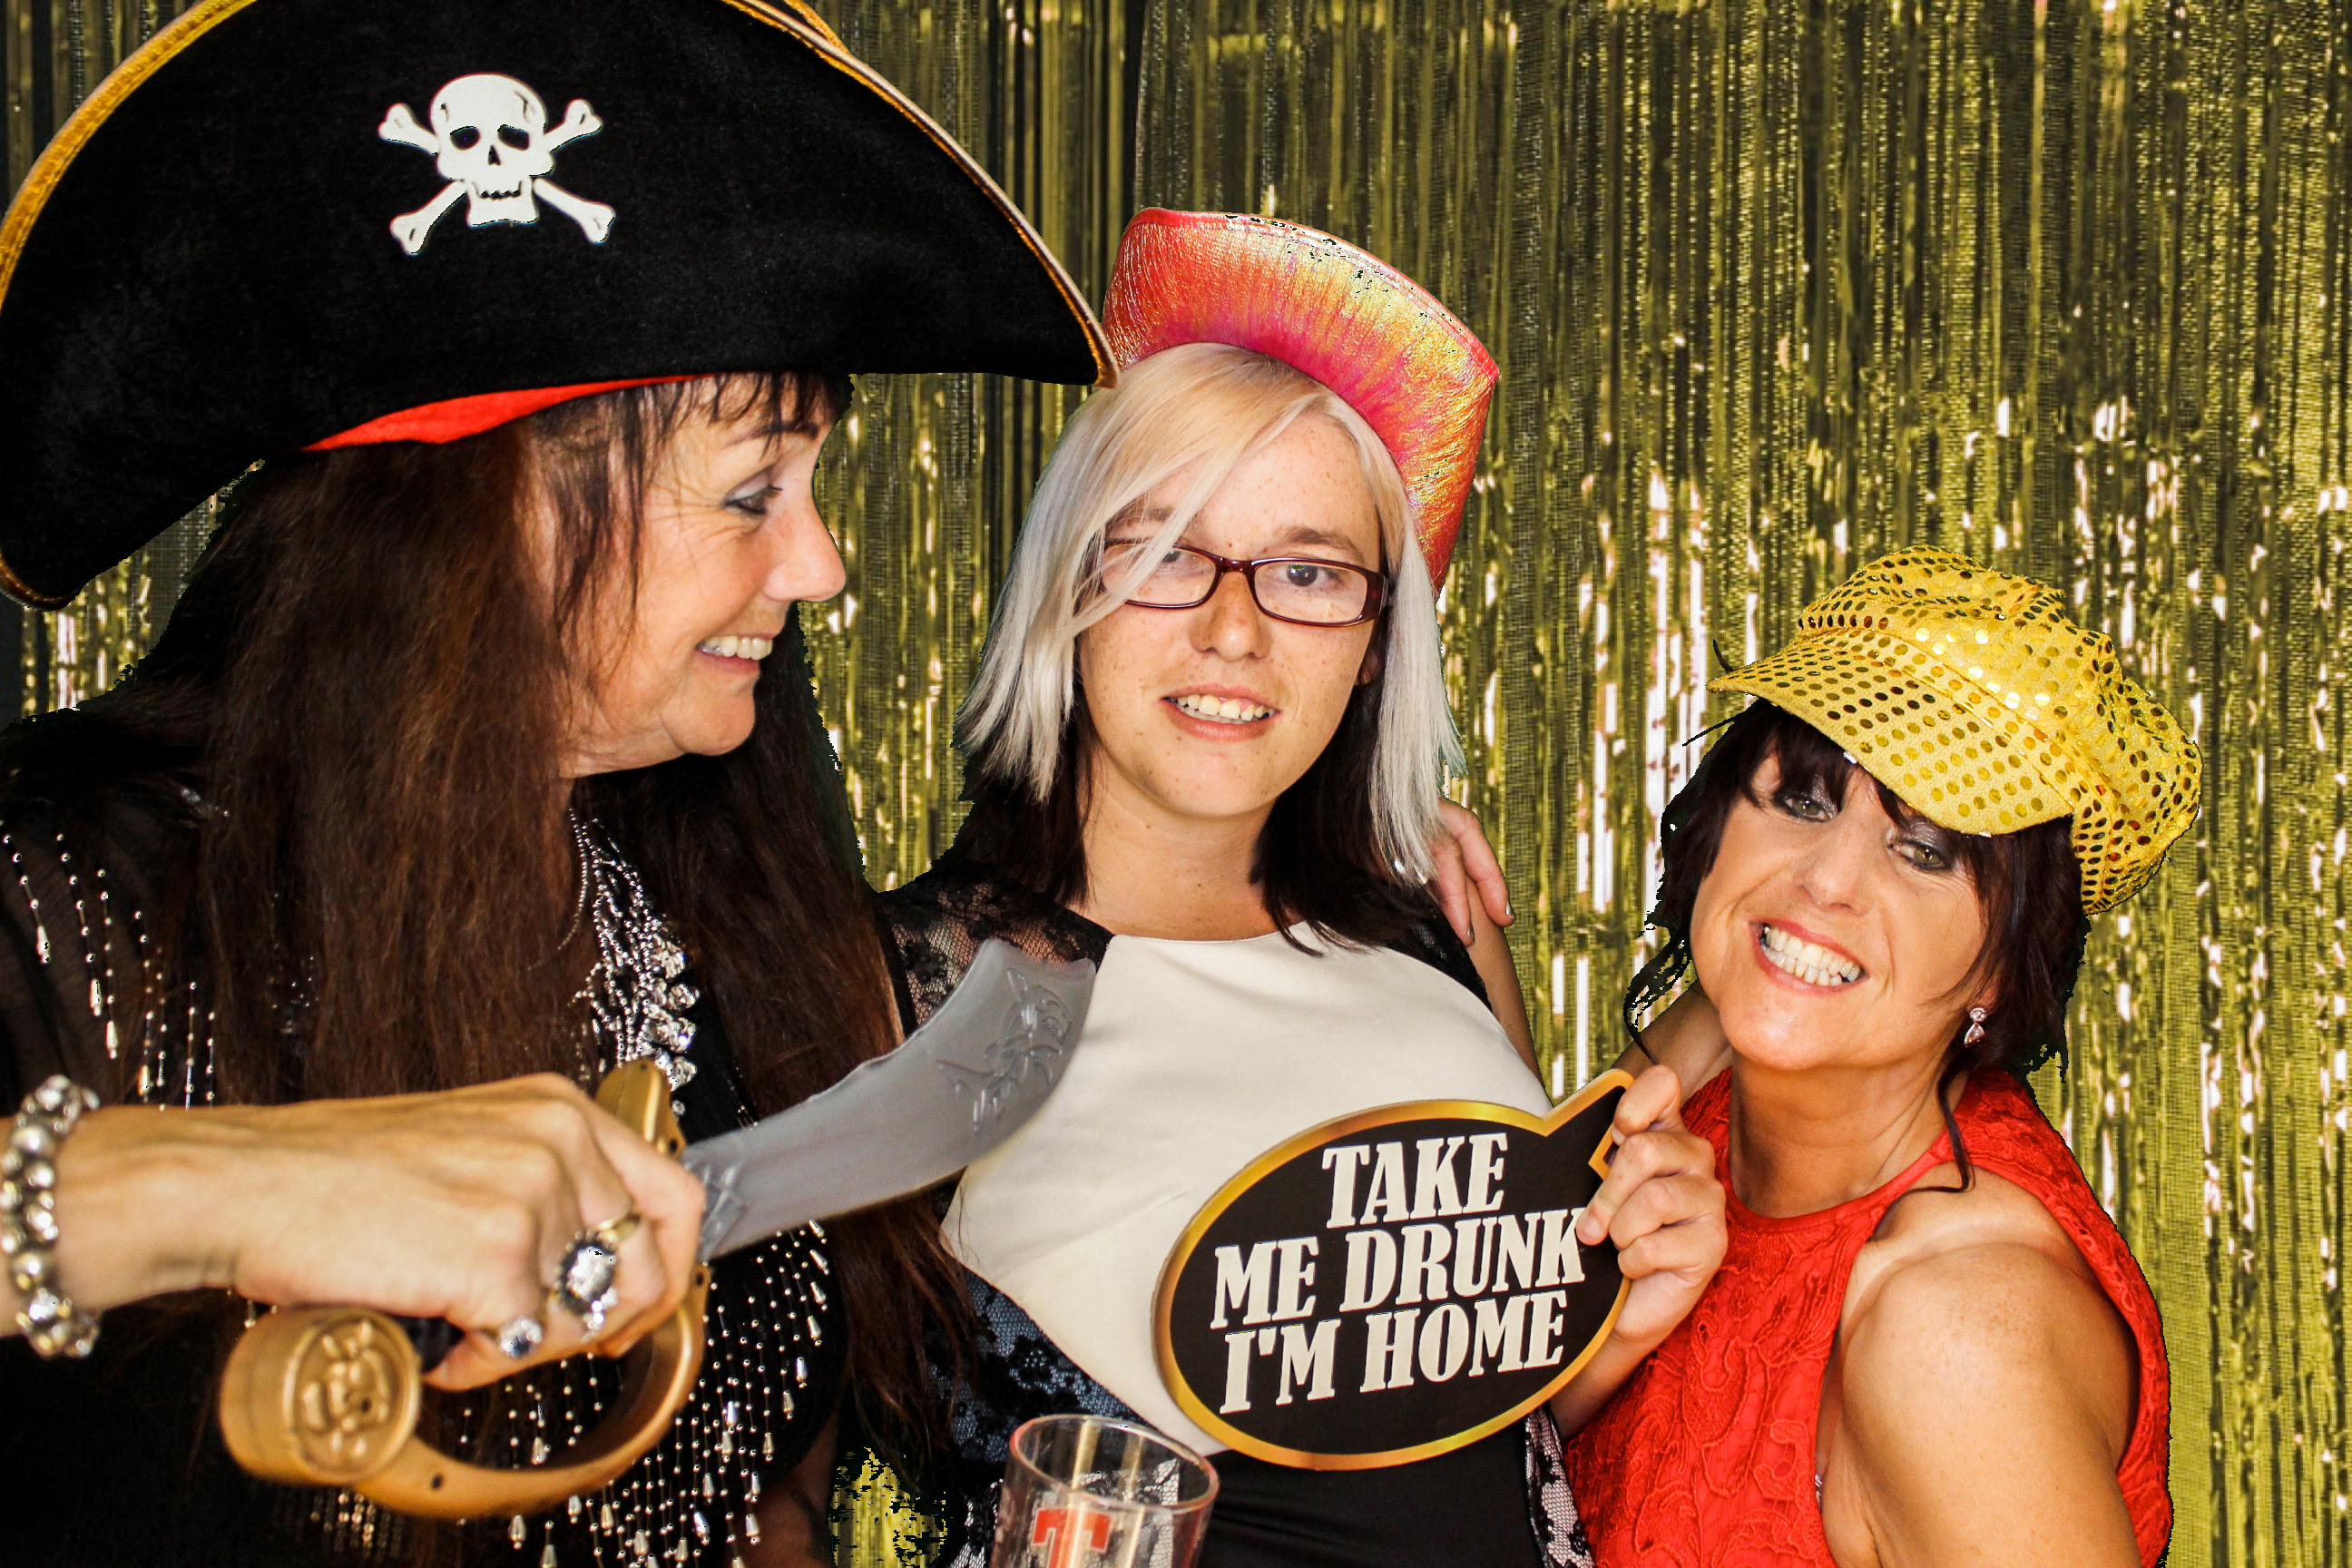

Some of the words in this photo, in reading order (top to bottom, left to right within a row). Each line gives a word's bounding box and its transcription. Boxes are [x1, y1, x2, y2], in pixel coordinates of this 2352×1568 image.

[1322, 1132, 1508, 1229] TAKE
[1210, 1237, 1318, 1329] ME
[1339, 1207, 1586, 1313] DRUNK
[1220, 1318, 1341, 1415] I'M
[1359, 1290, 1568, 1394] HOME
